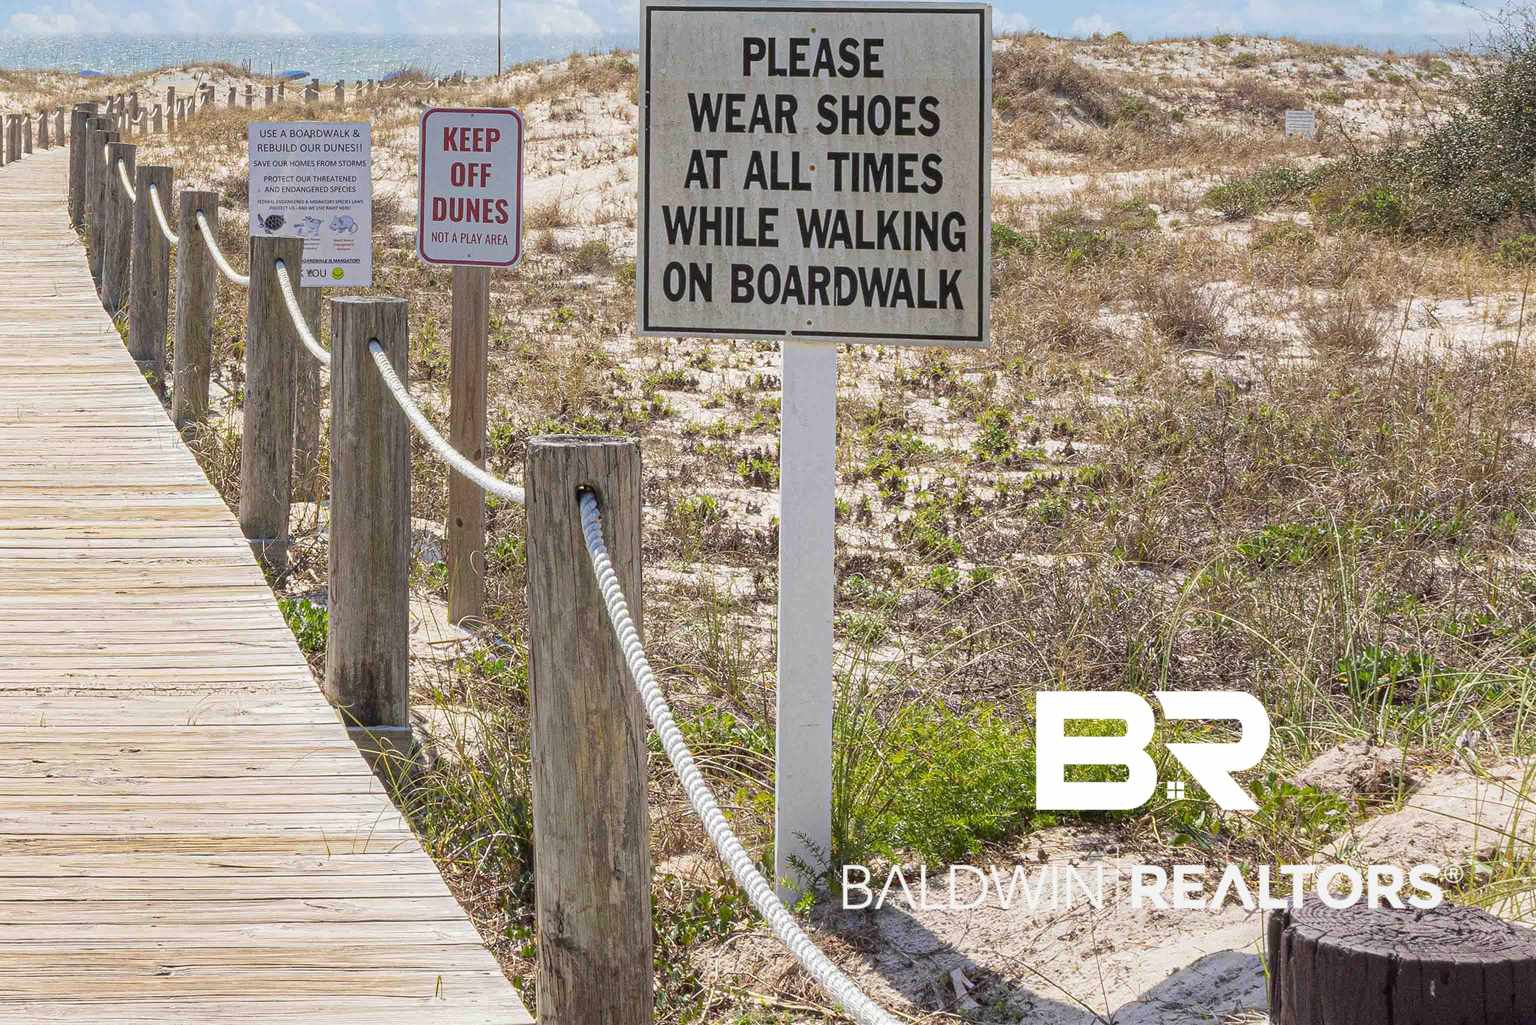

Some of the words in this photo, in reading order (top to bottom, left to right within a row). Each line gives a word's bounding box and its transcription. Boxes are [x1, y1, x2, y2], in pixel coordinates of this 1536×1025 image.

[742, 36, 885, 78] PLEASE
[687, 92, 798, 134] WEAR
[815, 94, 941, 137] SHOES
[259, 129, 277, 138] USE
[279, 129, 287, 138] A
[289, 129, 350, 138] BOARDWALK
[352, 129, 361, 138] &
[443, 127, 501, 152] KEEP
[257, 143, 298, 152] REBUILD
[299, 143, 321, 152] OUR
[323, 143, 363, 152] DUNES!!
[263, 175, 294, 183] PROTECT
[295, 175, 311, 183] OUR
[313, 175, 357, 183] THREATENED
[450, 161, 492, 187] OFF
[683, 149, 728, 189] AT
[743, 150, 812, 191] ALL
[827, 152, 943, 194] TIMES
[264, 185, 280, 193] AND
[281, 185, 328, 193] ENDANGERED
[329, 185, 357, 193] SPECIES
[432, 197, 509, 224] DUNES
[431, 231, 449, 243] NOT
[452, 232, 458, 243] A
[460, 233, 482, 244] PLAY
[485, 234, 508, 246] AREA
[662, 205, 779, 247] WHILE
[796, 208, 966, 252] WALKING
[306, 268, 327, 277] YOU
[663, 261, 713, 302] ON
[730, 263, 964, 310] BOARDWALK
